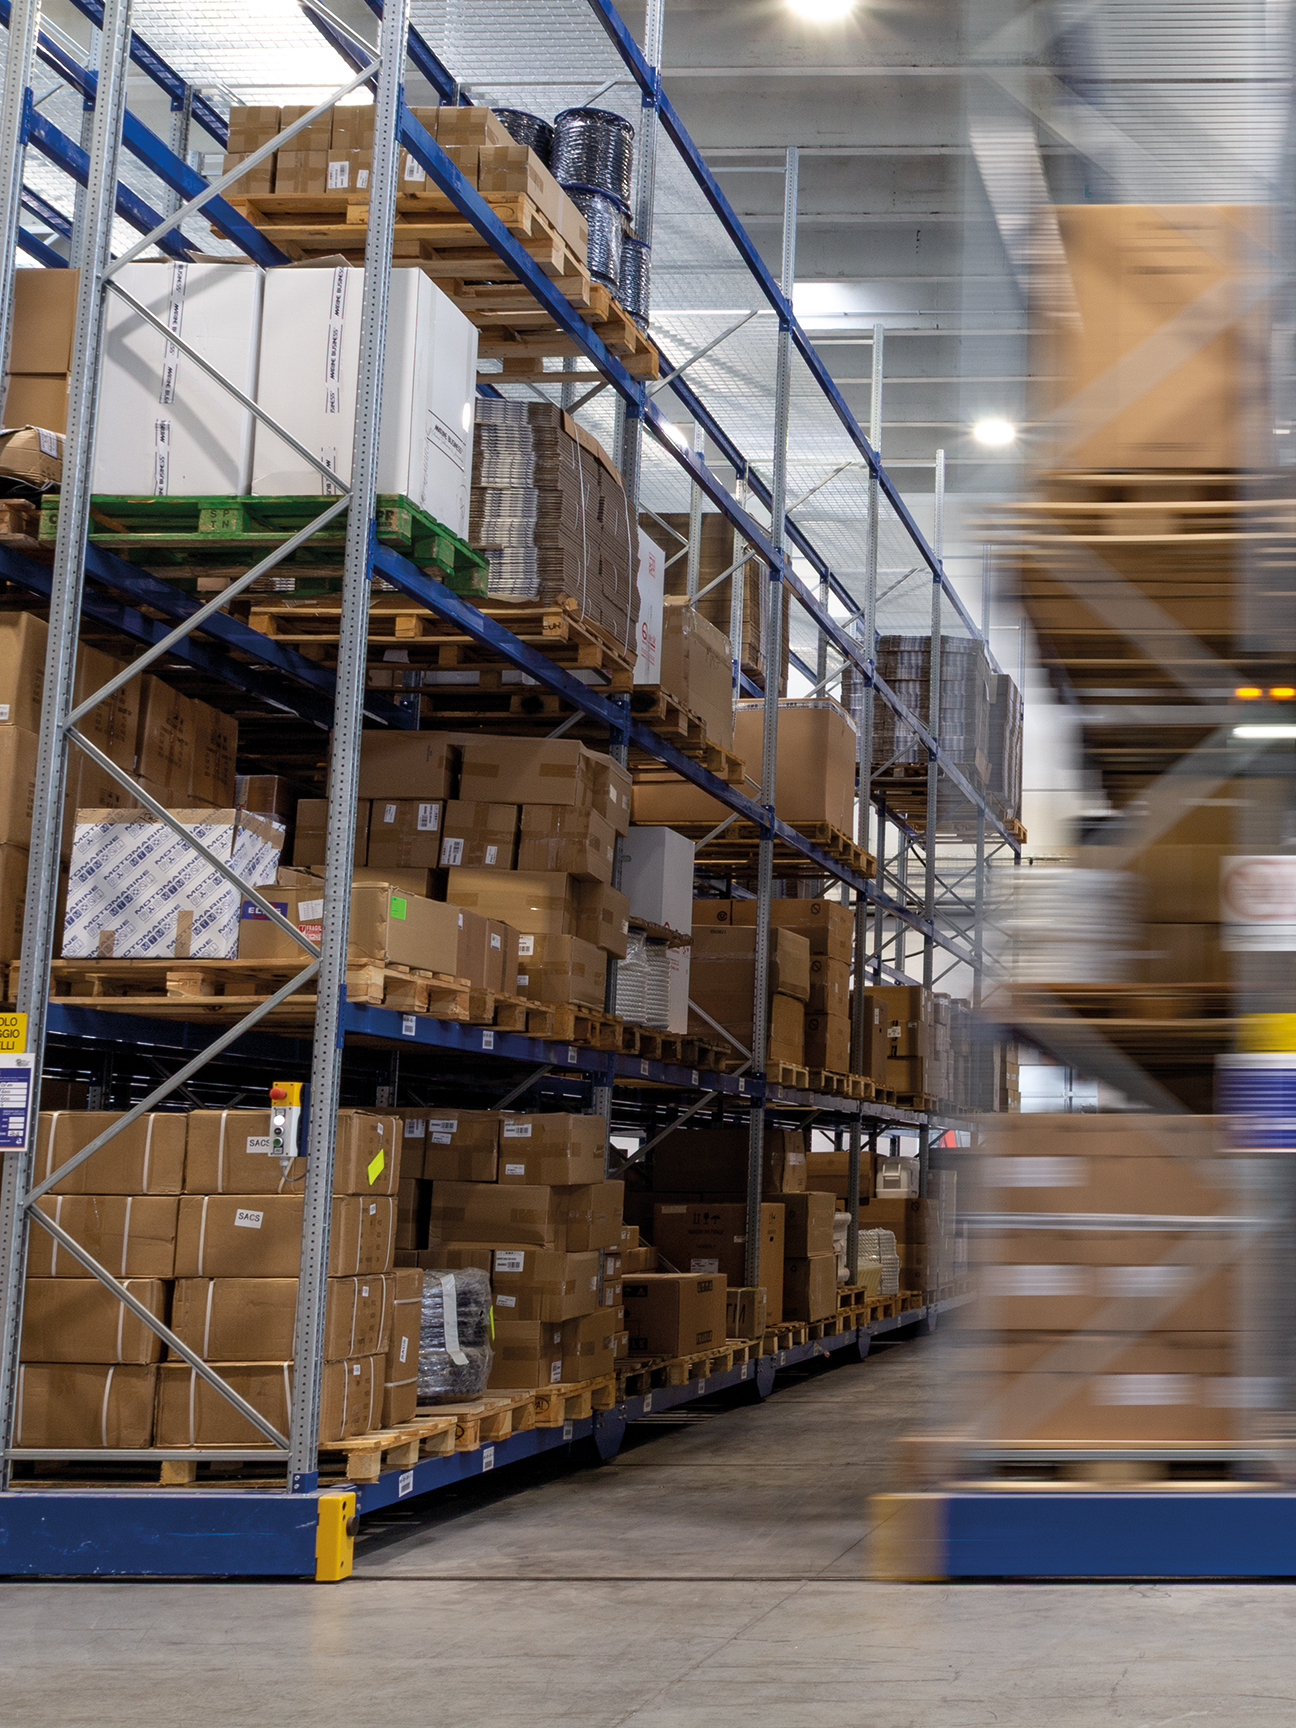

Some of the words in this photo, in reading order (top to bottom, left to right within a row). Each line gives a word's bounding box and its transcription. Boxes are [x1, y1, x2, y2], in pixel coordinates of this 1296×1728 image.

[83, 869, 151, 931] MOTOMARINE
[135, 855, 202, 916] MOTOMARINE
[166, 888, 233, 950] MOTOMARINE
[238, 1211, 261, 1223] SACS
